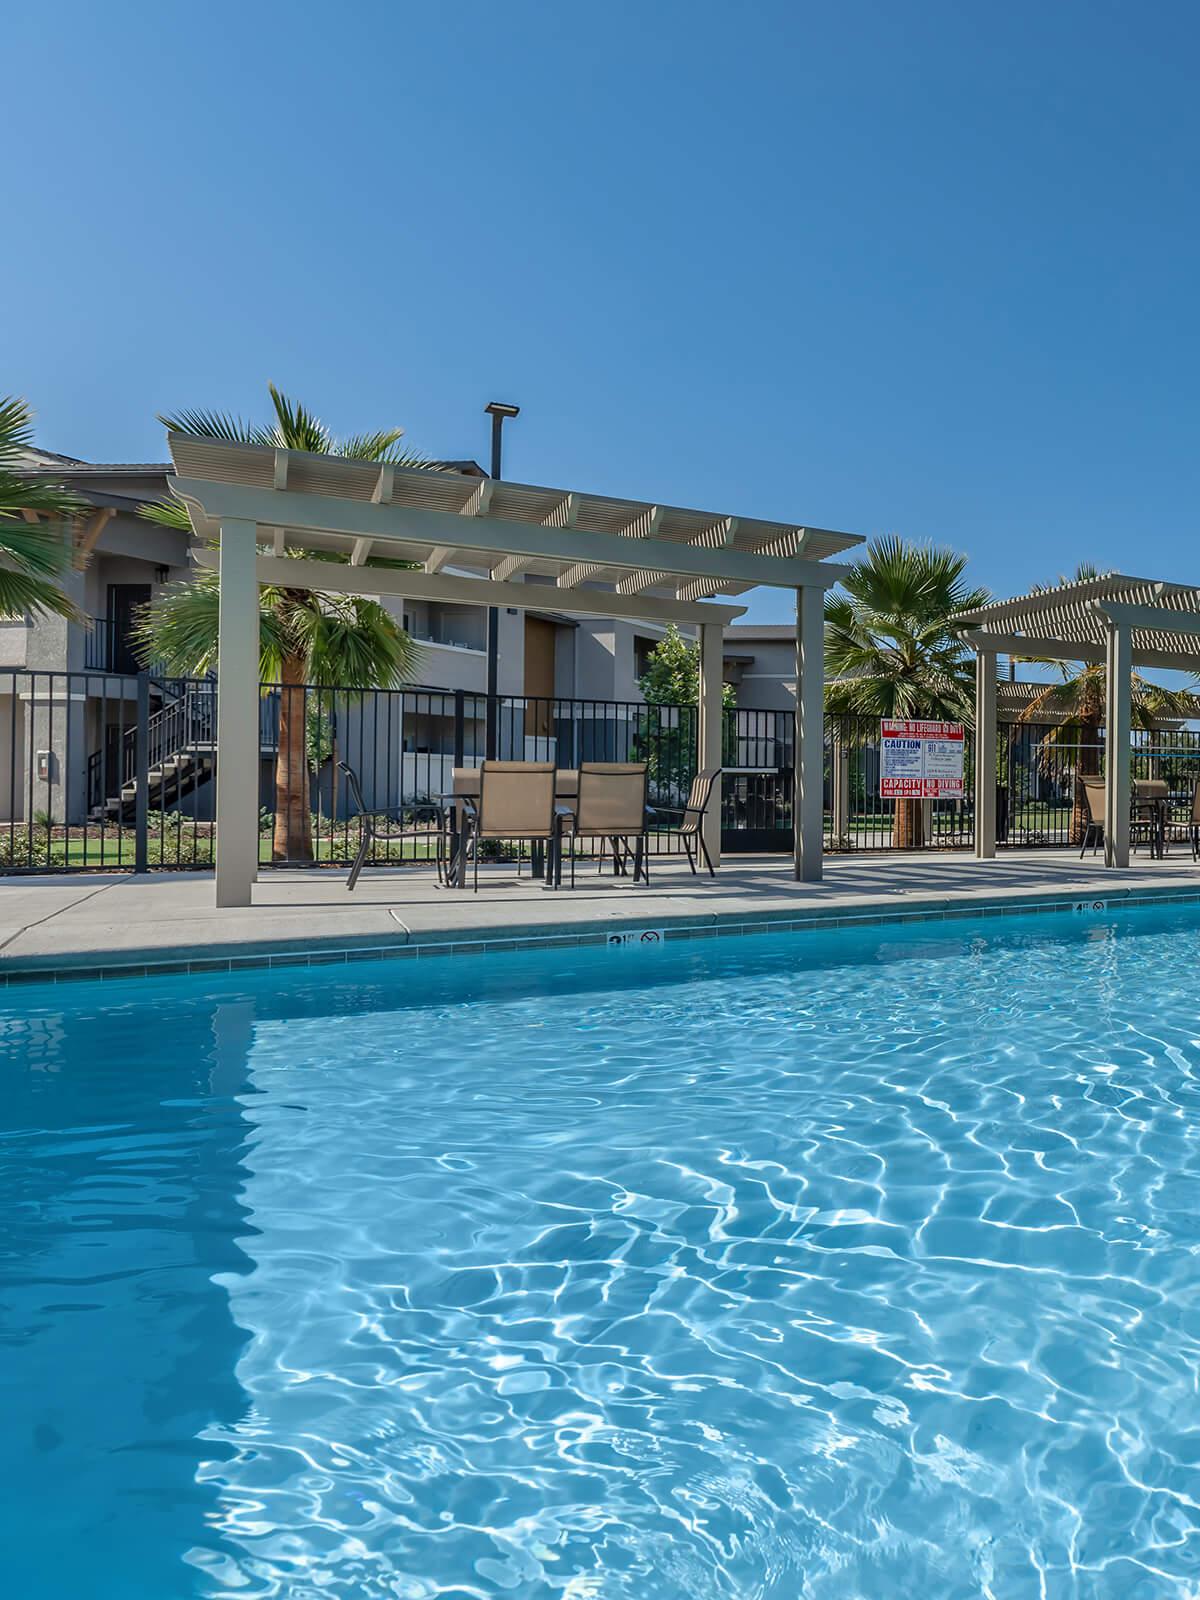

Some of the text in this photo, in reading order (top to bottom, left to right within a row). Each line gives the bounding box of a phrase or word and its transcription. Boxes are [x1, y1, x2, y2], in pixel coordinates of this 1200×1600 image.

[884, 740, 921, 749] CAUTION
[883, 779, 921, 789] CAPACITY
[926, 779, 961, 789] NO DIVING
